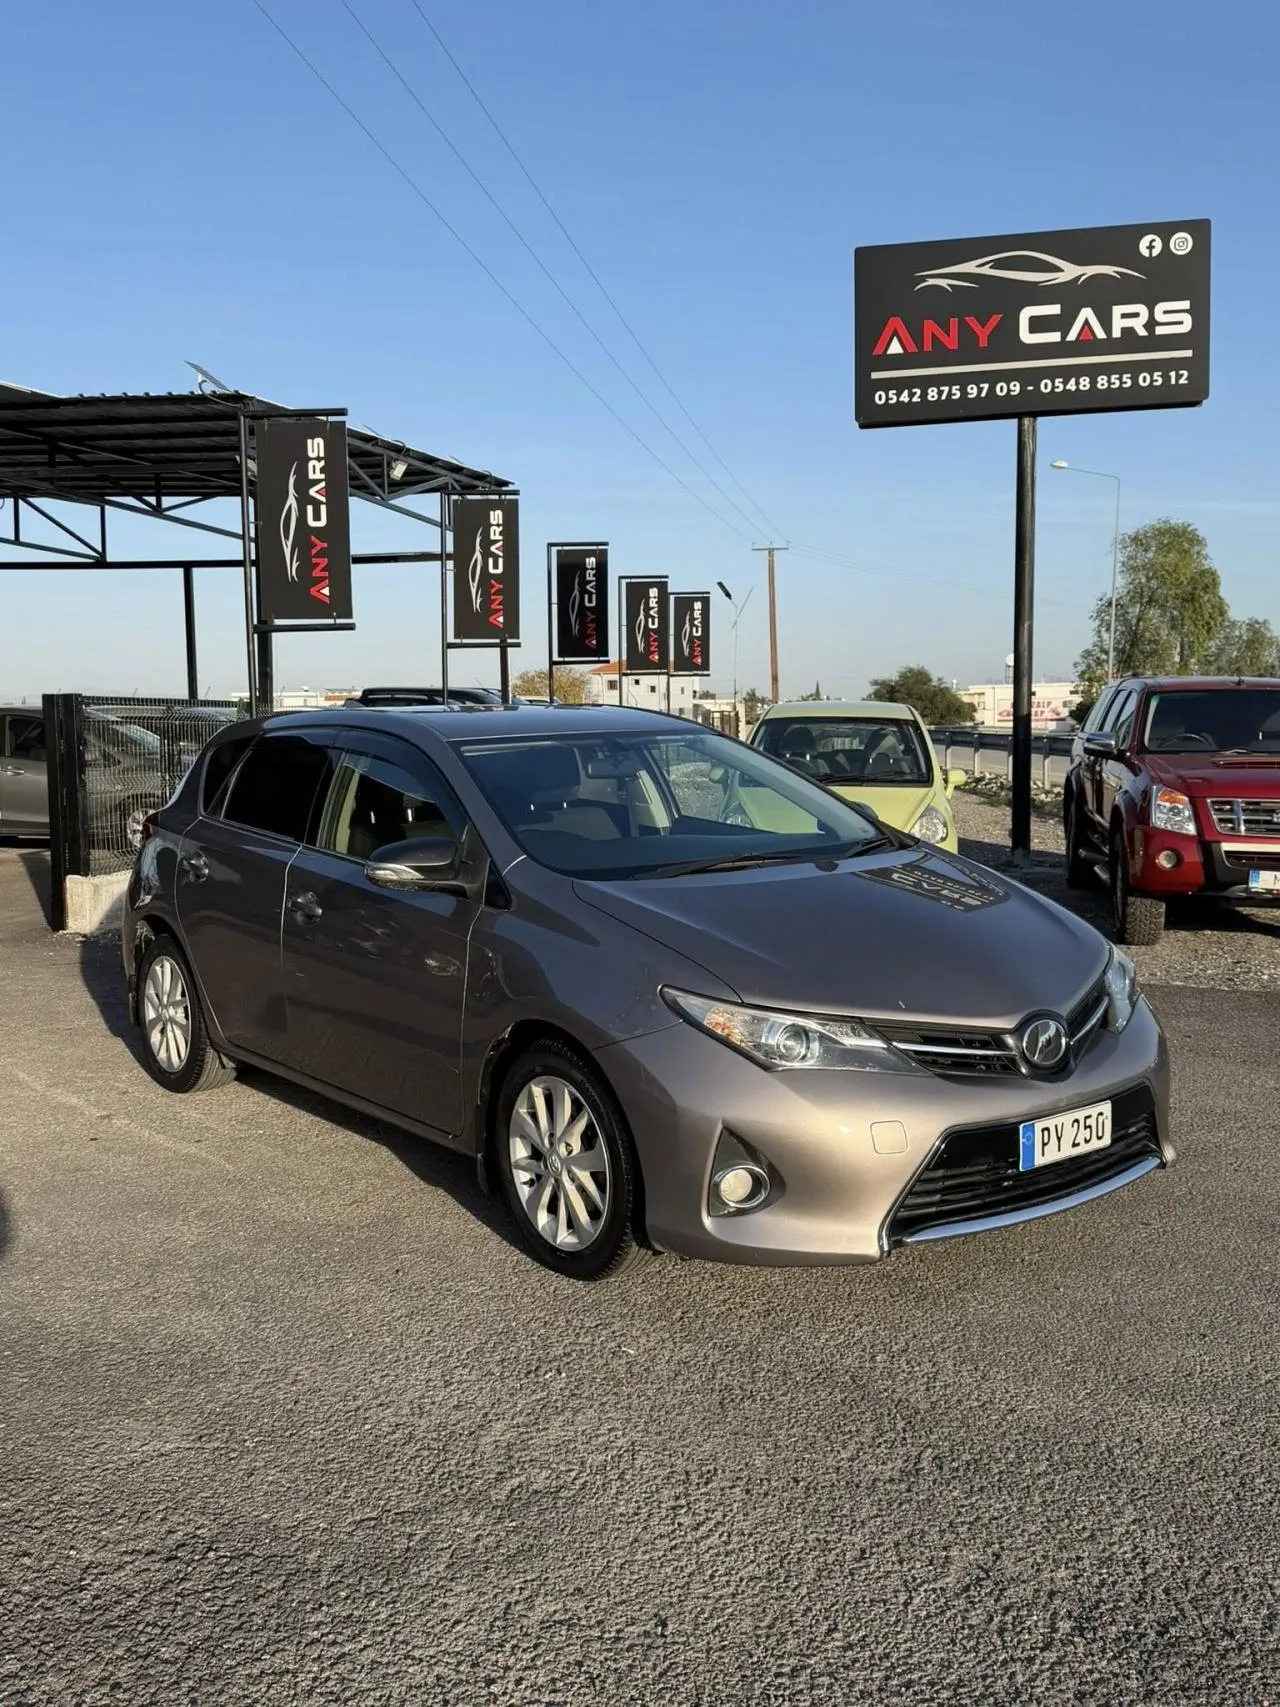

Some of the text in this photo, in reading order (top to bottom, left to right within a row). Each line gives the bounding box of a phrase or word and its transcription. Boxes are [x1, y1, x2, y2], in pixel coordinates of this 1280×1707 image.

[872, 300, 1193, 356] ANY CARS
[875, 388, 921, 405] 0542
[927, 385, 961, 402] 875
[967, 383, 989, 399] 97
[996, 381, 1021, 396] 09
[1040, 376, 1089, 393] 0548
[1096, 373, 1132, 390] 855
[1138, 371, 1162, 387] 05
[1170, 370, 1189, 385] 12
[307, 437, 330, 604] ANY CARS
[488, 509, 504, 629] ANY CARS
[584, 556, 597, 649] ANY CARS
[648, 587, 660, 663] ANY CARS
[692, 601, 702, 666] ANY CARS
[1041, 1111, 1106, 1157] PY 250
